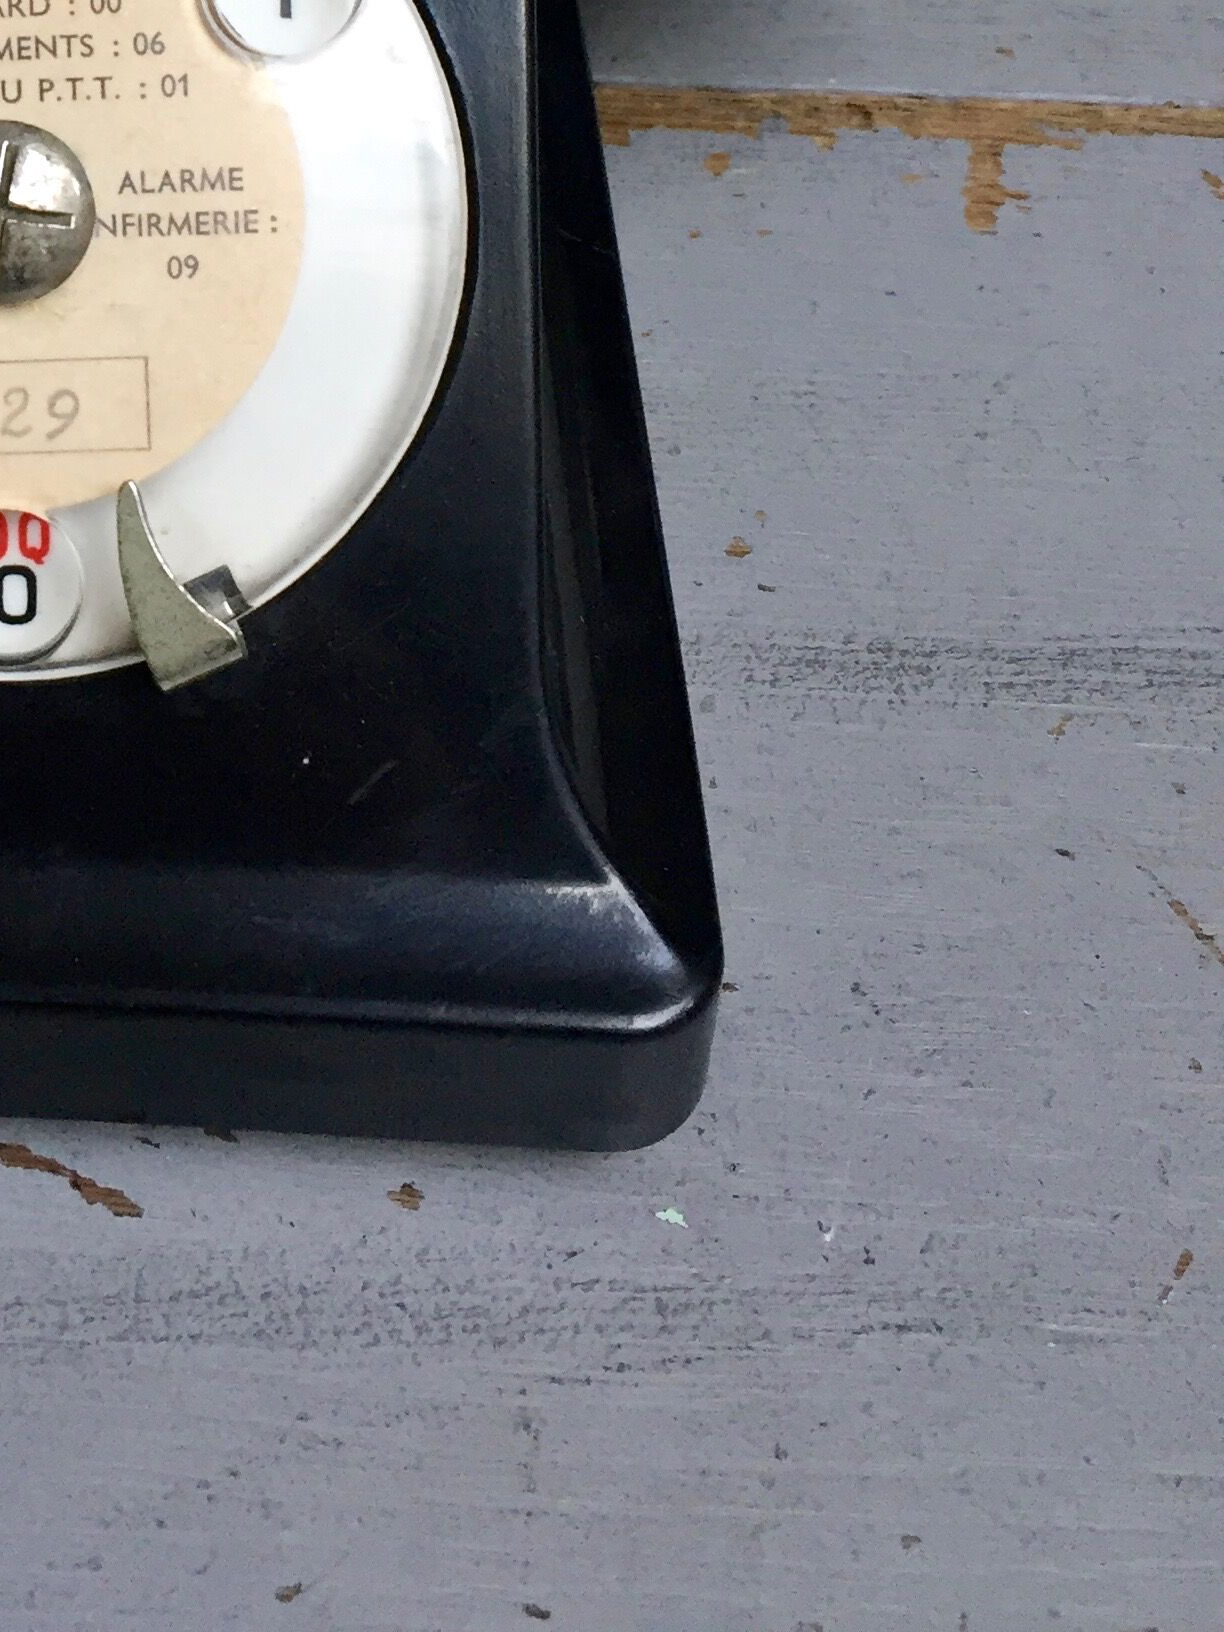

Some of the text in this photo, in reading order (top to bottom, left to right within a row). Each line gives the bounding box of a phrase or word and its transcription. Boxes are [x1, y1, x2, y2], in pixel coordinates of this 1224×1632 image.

[132, 31, 166, 57] 06
[38, 76, 121, 103] P.T.T.
[160, 73, 189, 98] 01
[117, 166, 244, 196] ALARME
[95, 209, 259, 238] NFIRMERIE
[166, 254, 200, 280] 09
